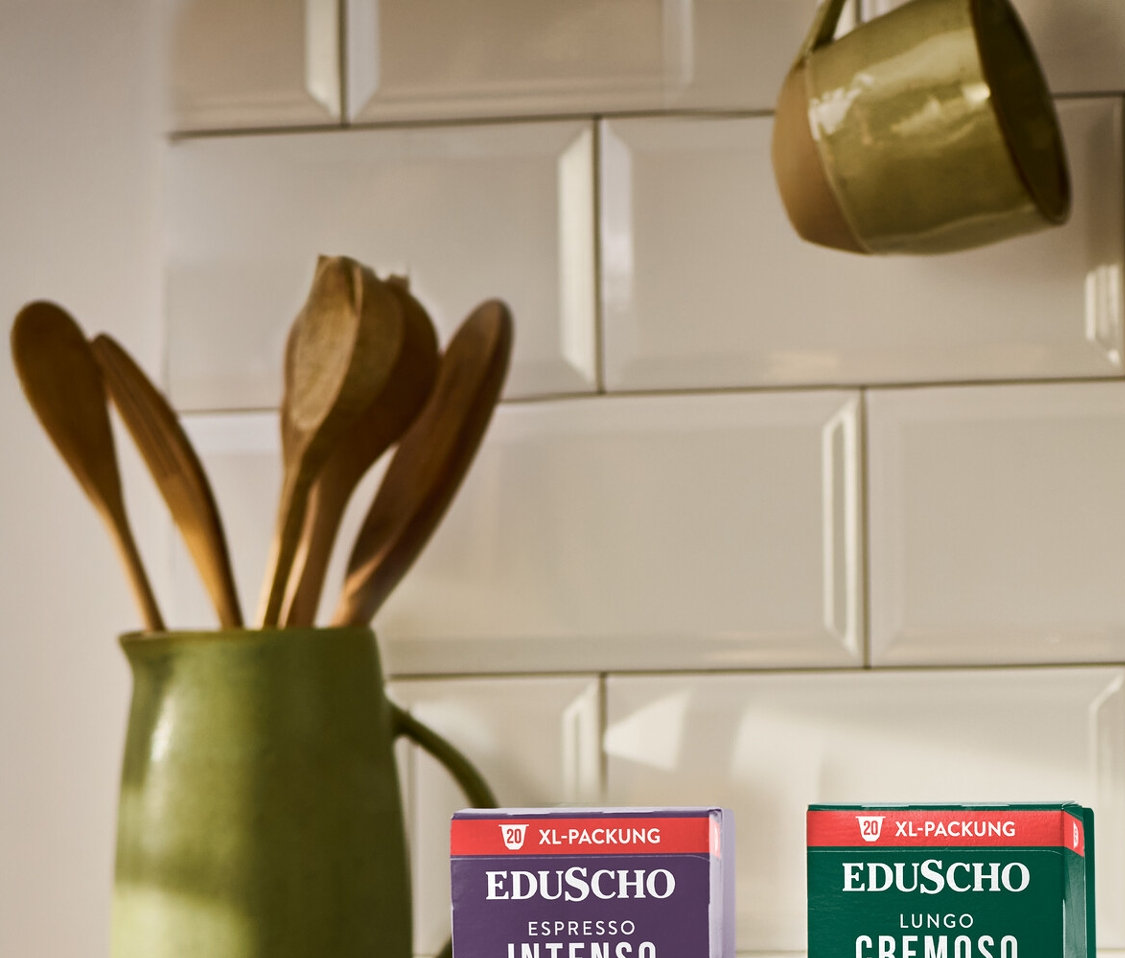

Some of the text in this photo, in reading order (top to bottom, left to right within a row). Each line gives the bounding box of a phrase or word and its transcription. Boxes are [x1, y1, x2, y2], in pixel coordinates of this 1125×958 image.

[507, 828, 661, 845] 20 XL-PACKUNG
[864, 820, 1016, 837] 20 XL-PACKUNG
[486, 867, 676, 901] EDUSCHO
[842, 859, 1030, 894] EDUSCHO
[528, 920, 635, 936] ESPRESSO
[900, 914, 974, 929] LUNGO
